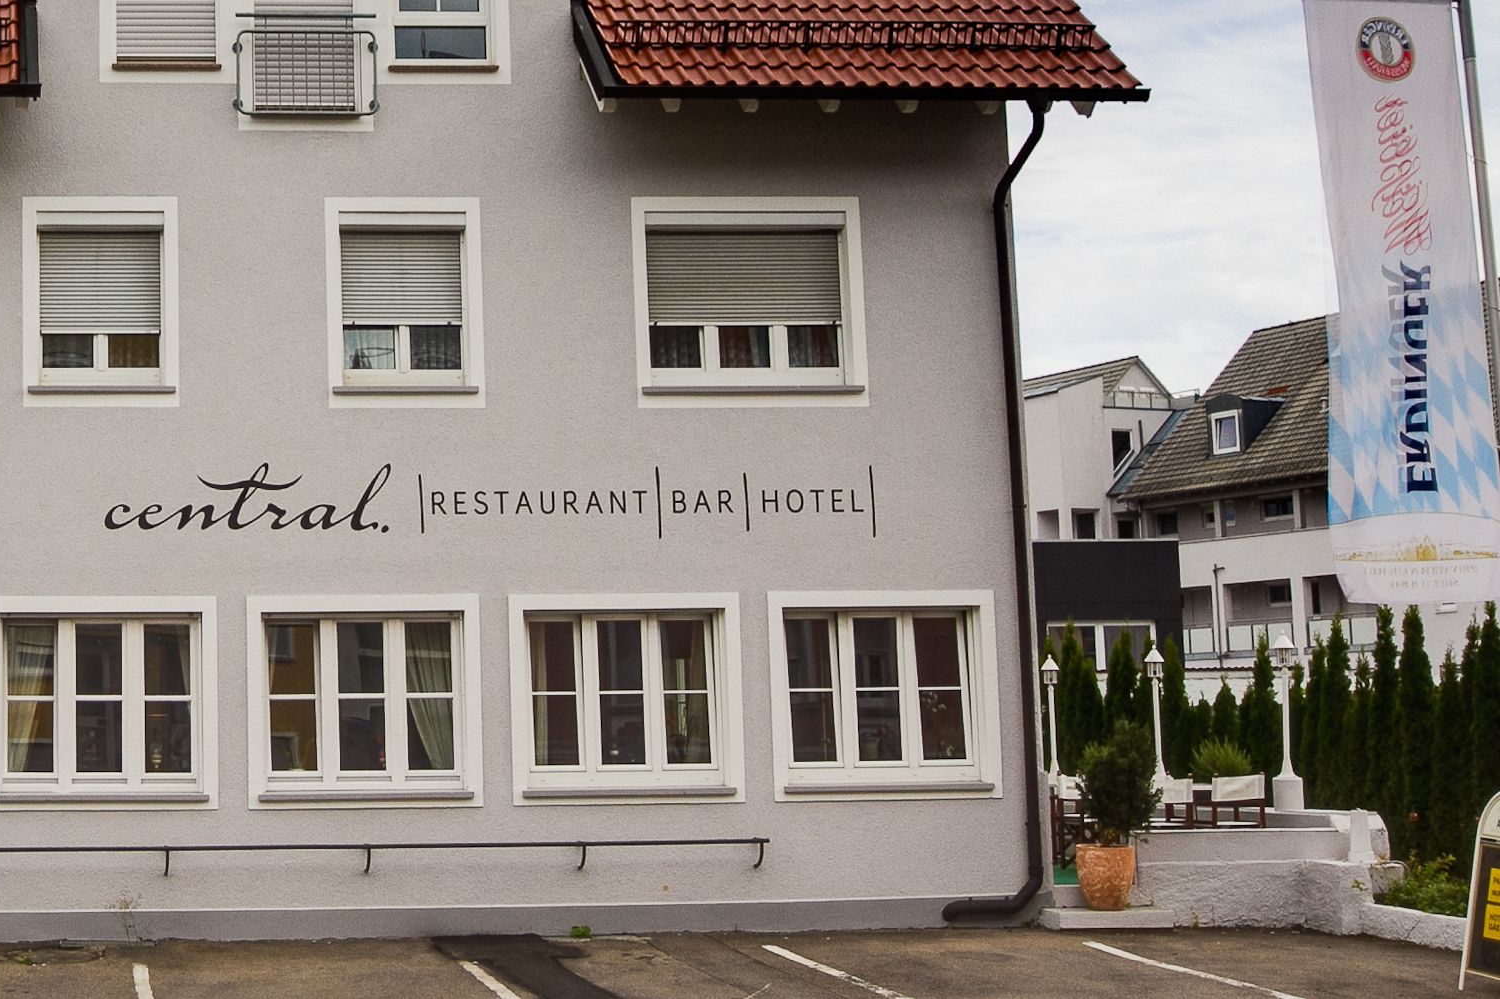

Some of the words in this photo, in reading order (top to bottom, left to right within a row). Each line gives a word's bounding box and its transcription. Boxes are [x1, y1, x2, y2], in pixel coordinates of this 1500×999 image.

[431, 490, 649, 515] RESTAURANT
[671, 490, 734, 514] BAR
[761, 488, 865, 513] HOTEL
